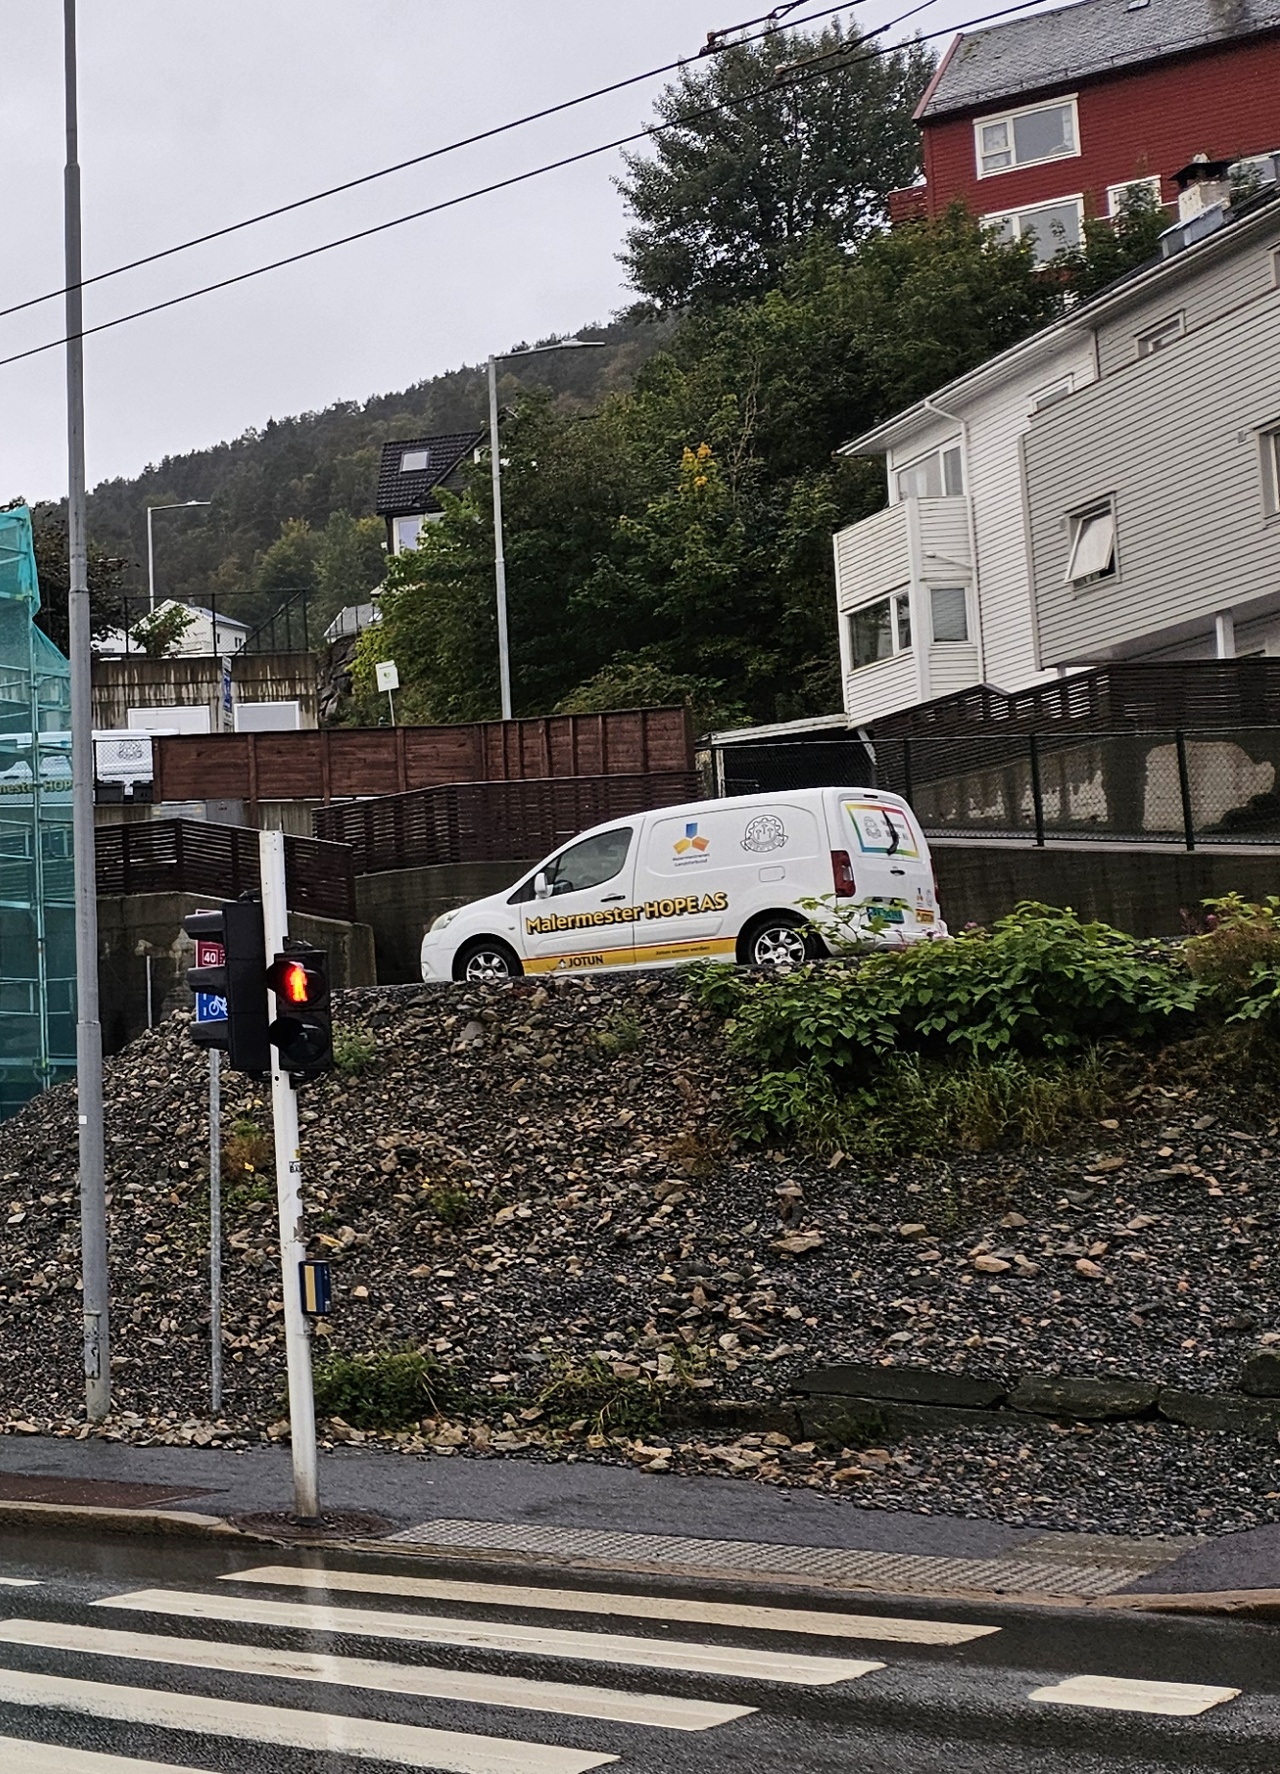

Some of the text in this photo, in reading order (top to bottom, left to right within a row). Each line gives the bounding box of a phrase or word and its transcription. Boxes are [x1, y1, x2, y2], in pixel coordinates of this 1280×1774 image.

[525, 891, 729, 936] Malermester HOPE AS
[204, 951, 216, 963] 40
[568, 954, 604, 969] JOTUN
